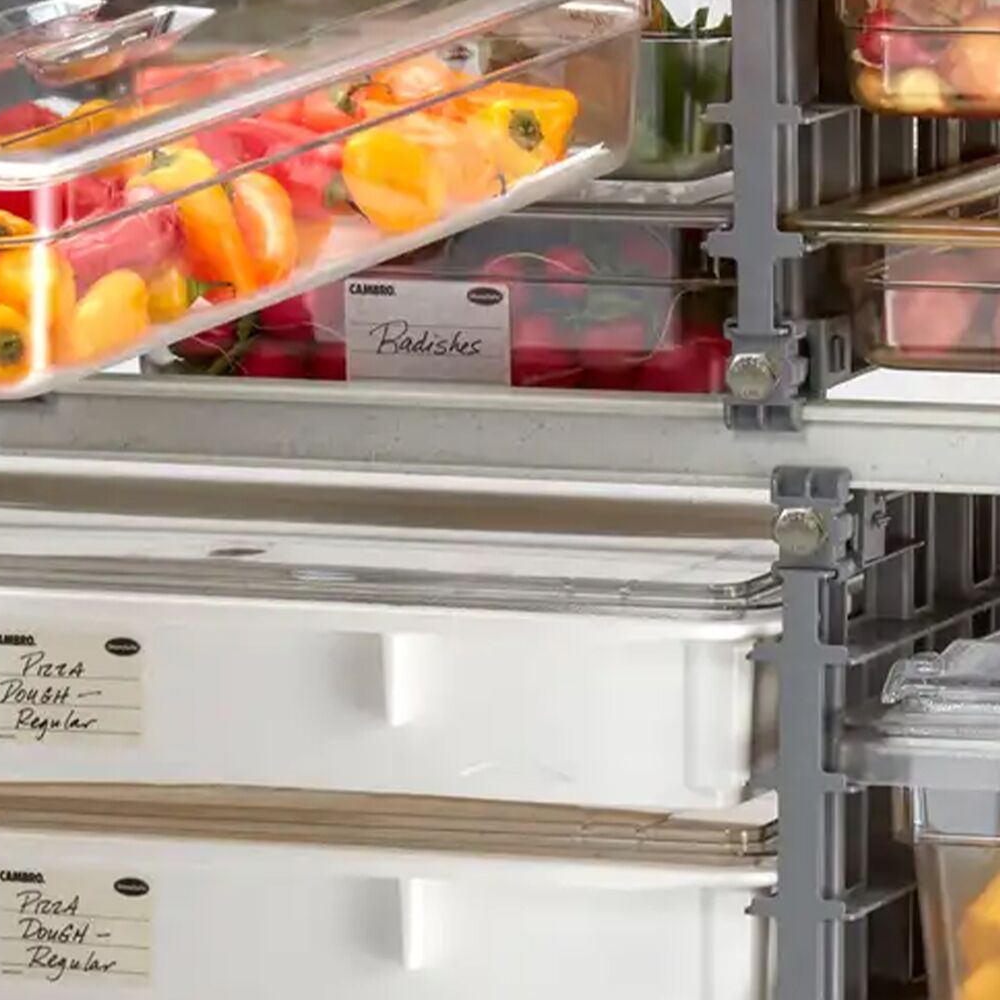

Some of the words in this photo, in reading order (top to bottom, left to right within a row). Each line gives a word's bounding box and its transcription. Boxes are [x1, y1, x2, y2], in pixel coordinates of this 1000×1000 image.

[369, 319, 482, 356] Radishes
[15, 707, 98, 741] Regular
[26, 945, 116, 981] Regular
